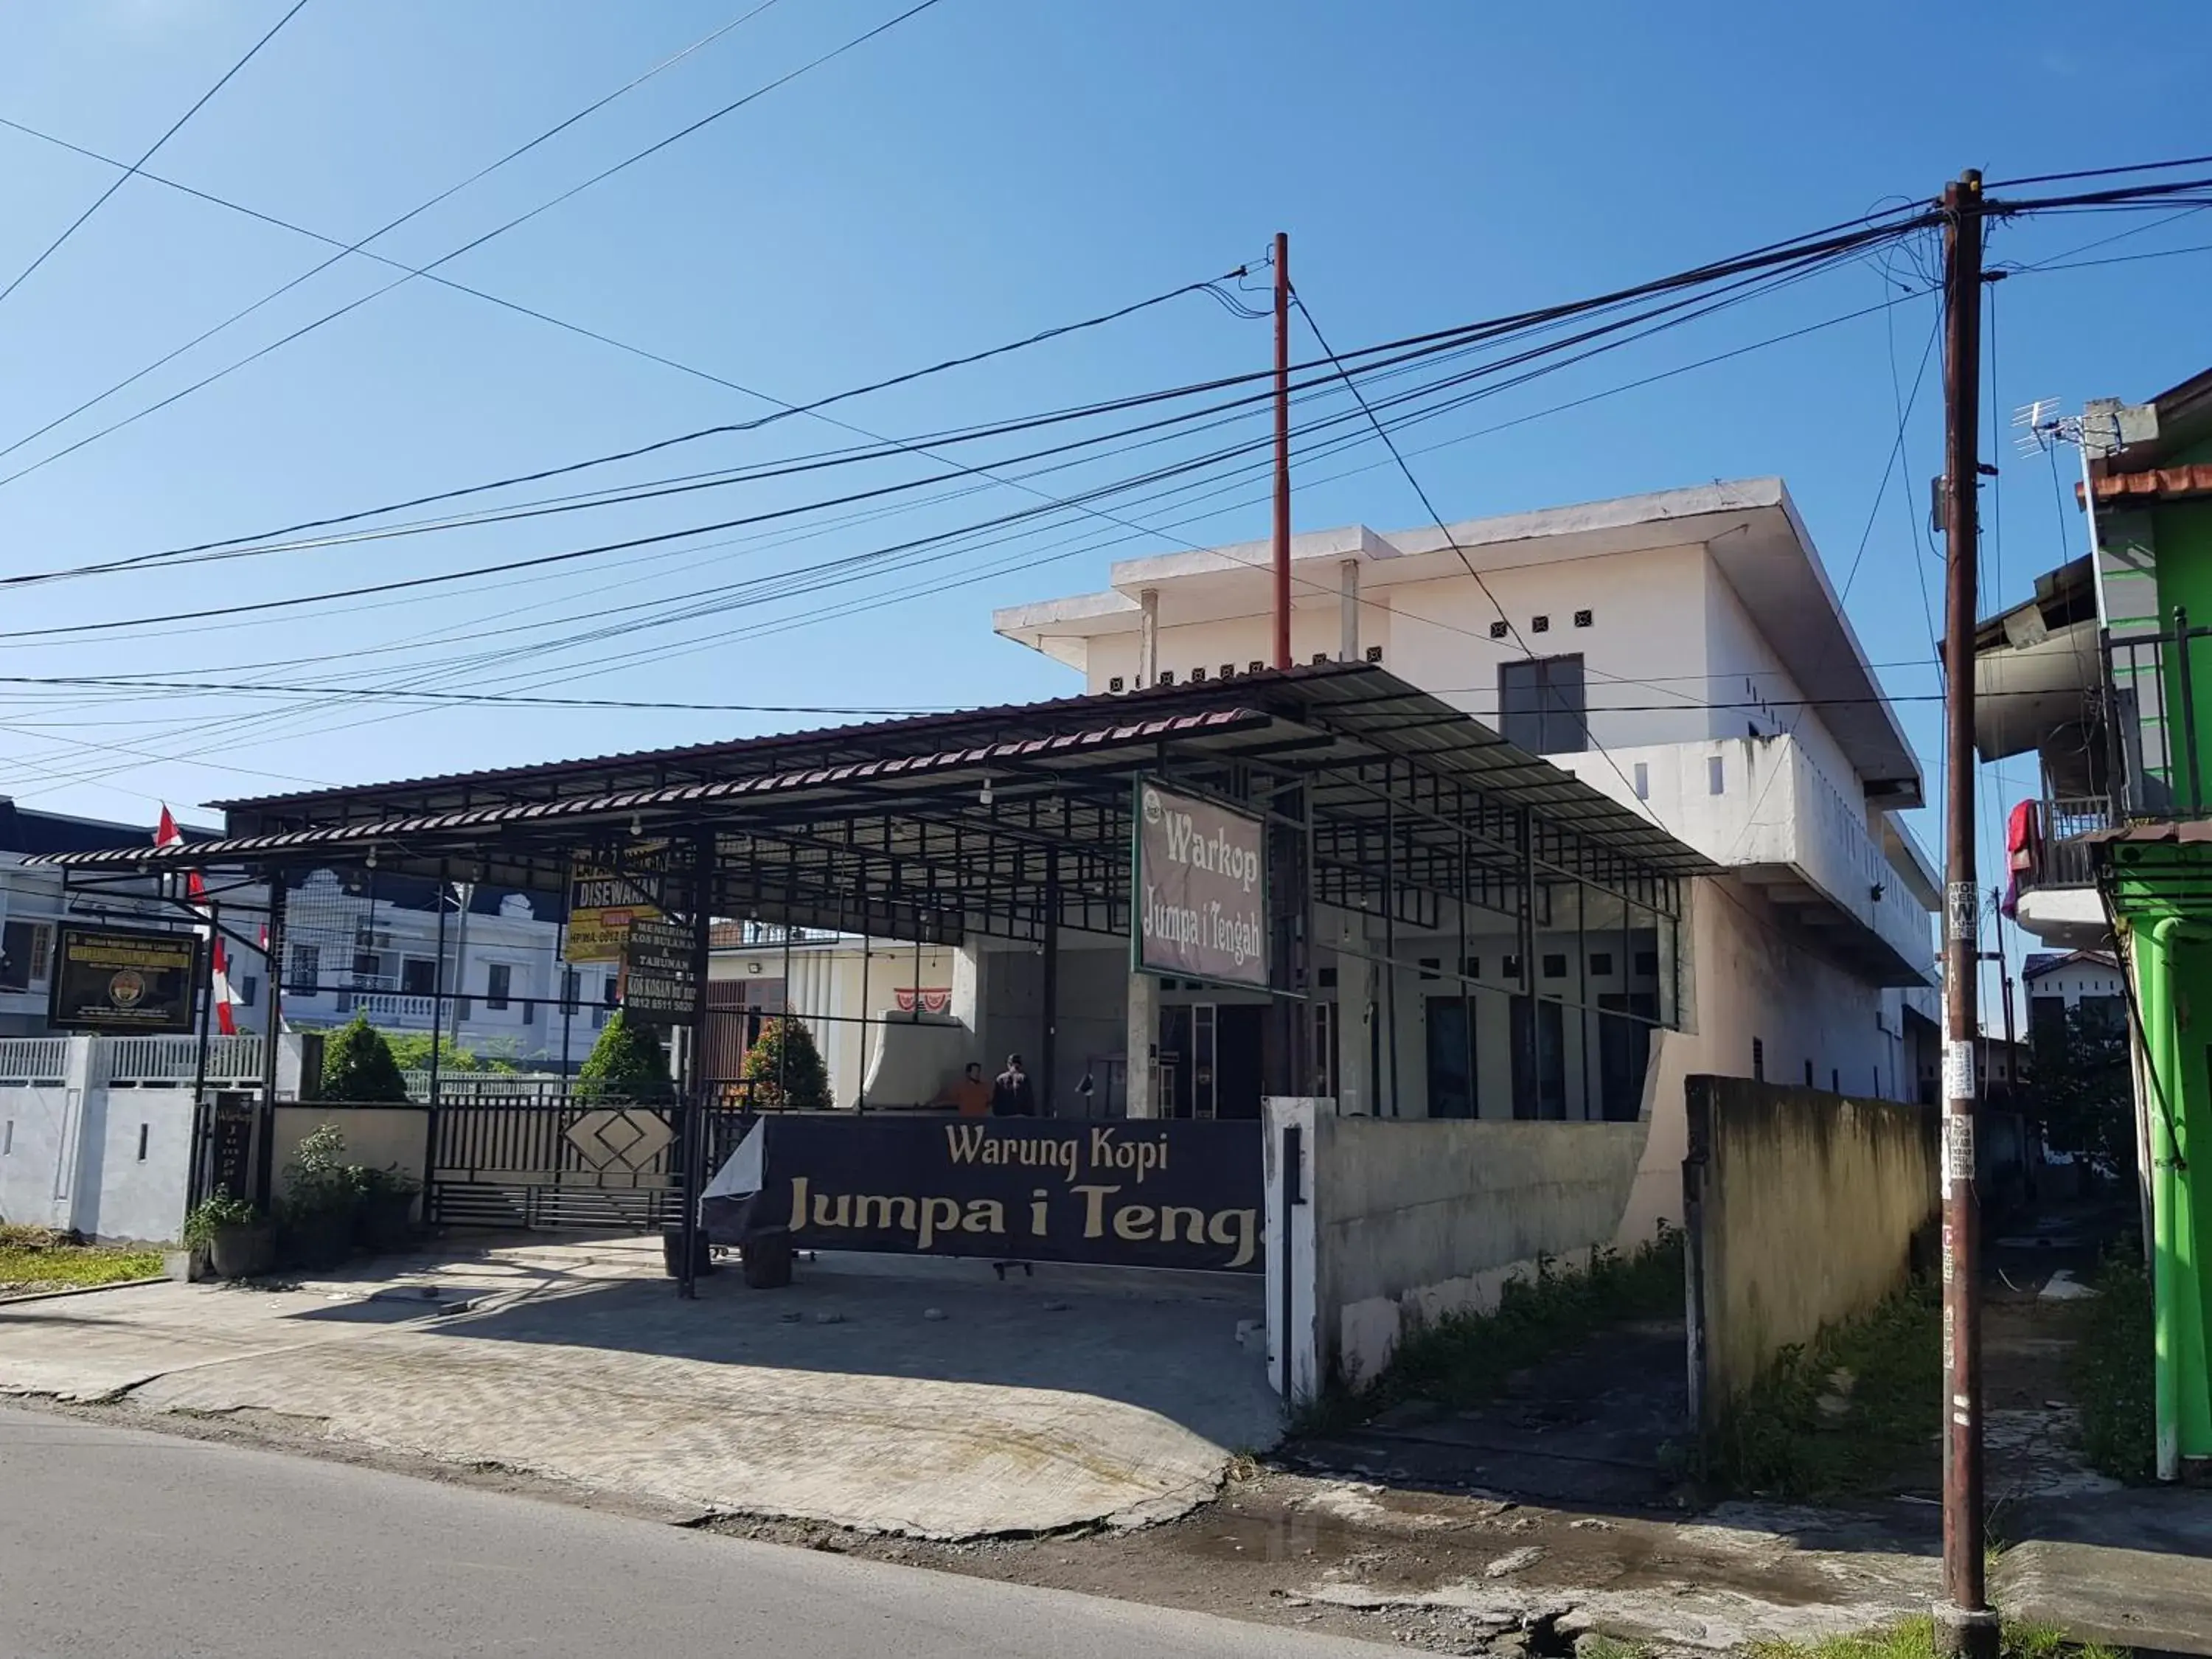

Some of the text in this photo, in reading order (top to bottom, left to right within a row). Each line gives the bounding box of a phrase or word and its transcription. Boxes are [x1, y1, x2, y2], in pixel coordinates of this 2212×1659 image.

[1163, 807, 1257, 892] Warkop
[631, 933, 651, 944] KOS
[638, 923, 694, 939] MENERIMA
[1144, 885, 1260, 966] Jumpa i Tengah
[639, 955, 689, 970] TAHUNAN
[945, 1124, 1167, 1183] Warung Kopi
[789, 1177, 1265, 1267] Jumpa i Teng
